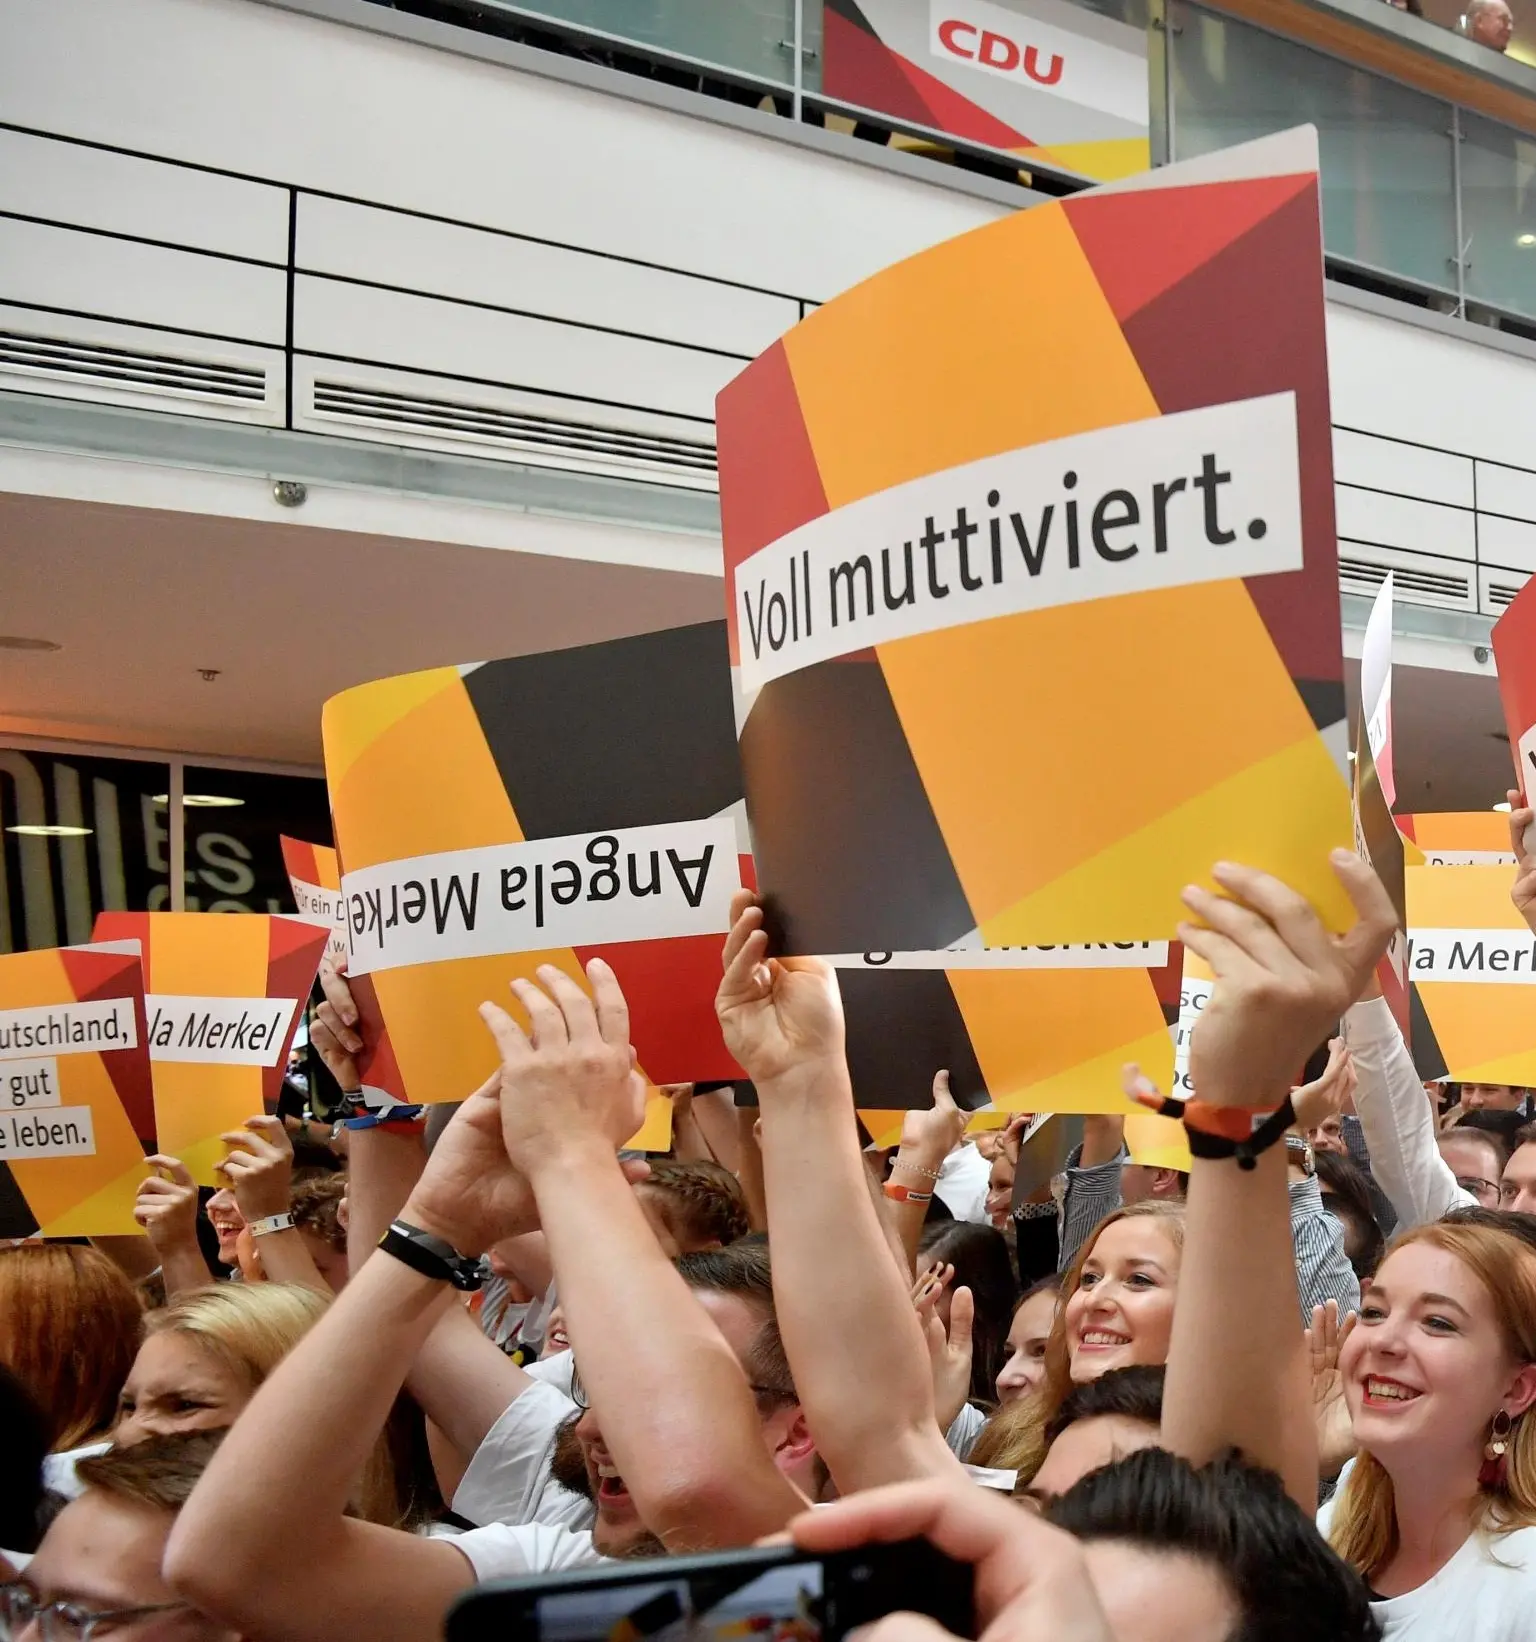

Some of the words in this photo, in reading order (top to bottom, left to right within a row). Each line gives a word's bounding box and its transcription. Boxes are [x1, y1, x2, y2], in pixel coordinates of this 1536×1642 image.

[938, 20, 1065, 85] CDU
[743, 550, 813, 661] Voll
[829, 453, 1268, 628] muttiviert.
[311, 894, 331, 914] ein
[502, 834, 714, 928] Angela
[346, 872, 480, 955] Merkel
[178, 1011, 282, 1051] Merkel
[10, 1068, 52, 1106] gut
[12, 1117, 88, 1148] leben.
